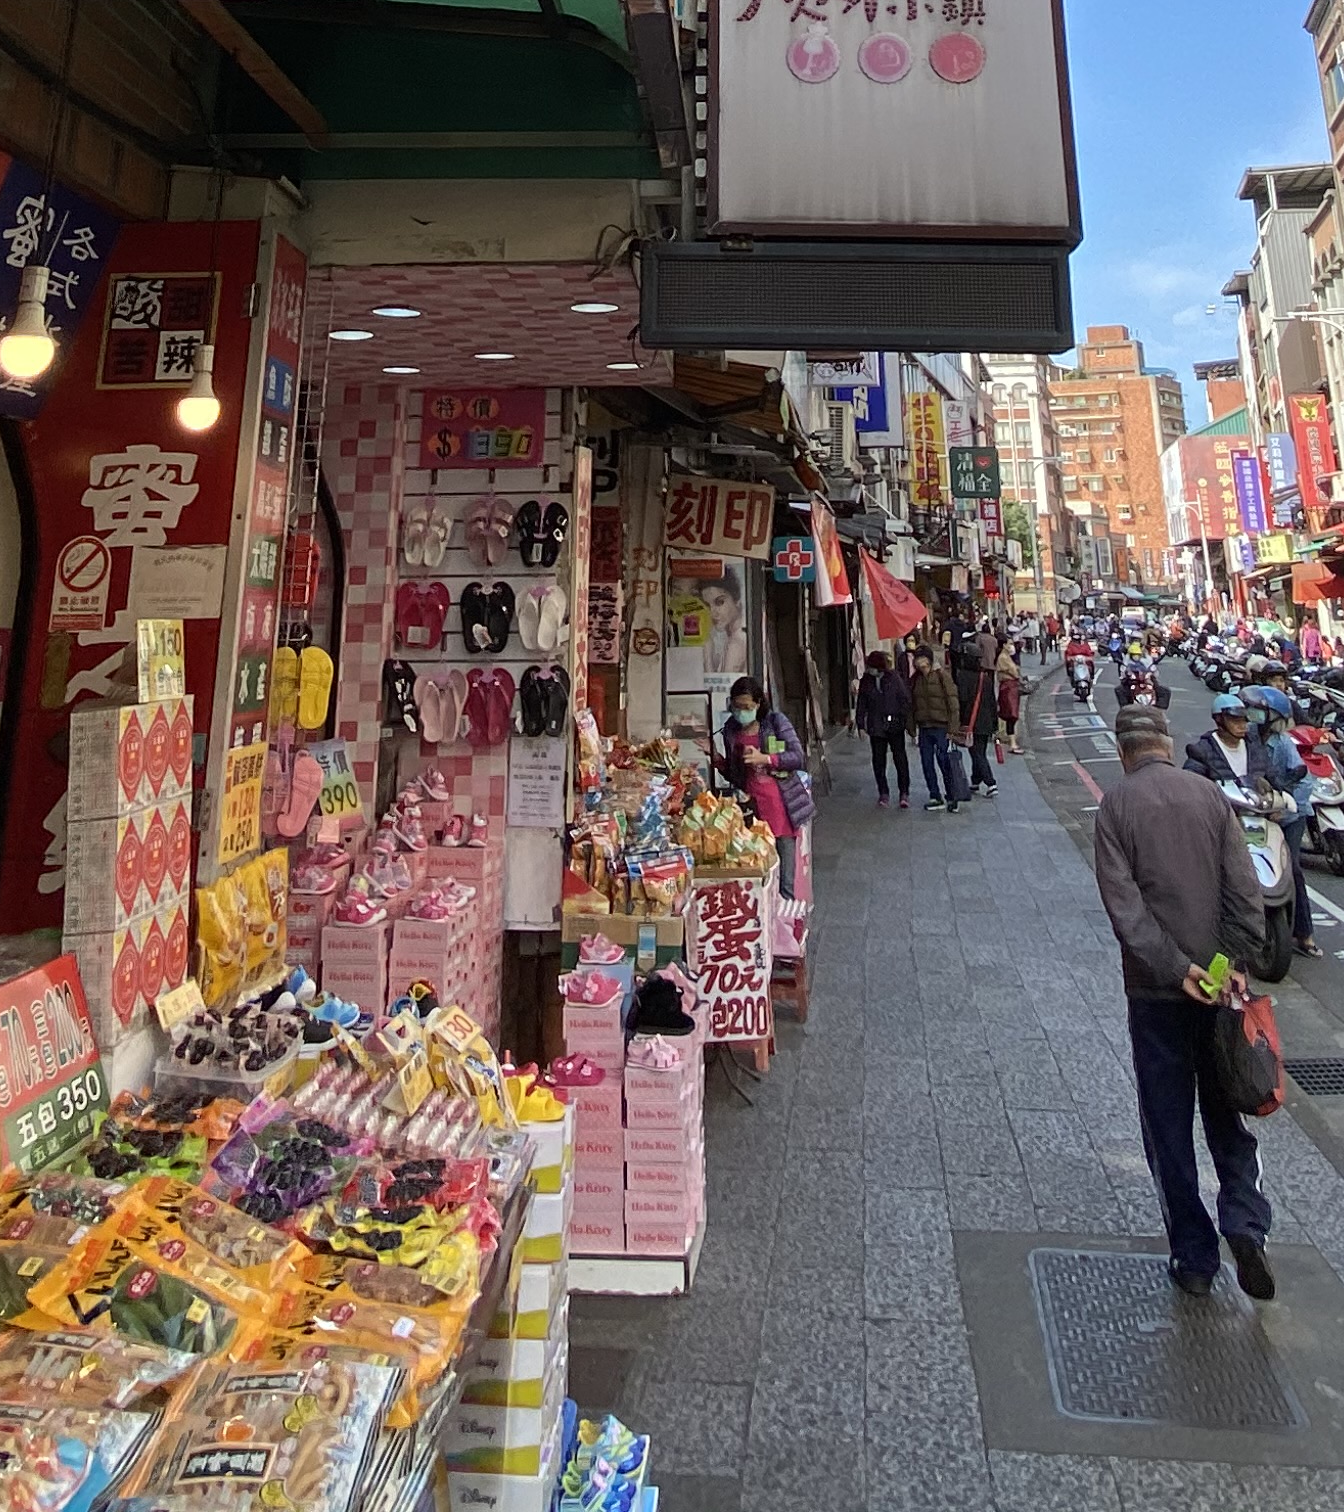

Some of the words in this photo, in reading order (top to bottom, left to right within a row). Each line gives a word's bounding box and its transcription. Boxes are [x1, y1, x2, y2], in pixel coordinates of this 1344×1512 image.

[666, 481, 773, 552] 刻印
[321, 781, 358, 816] 390
[697, 962, 764, 995] 70元
